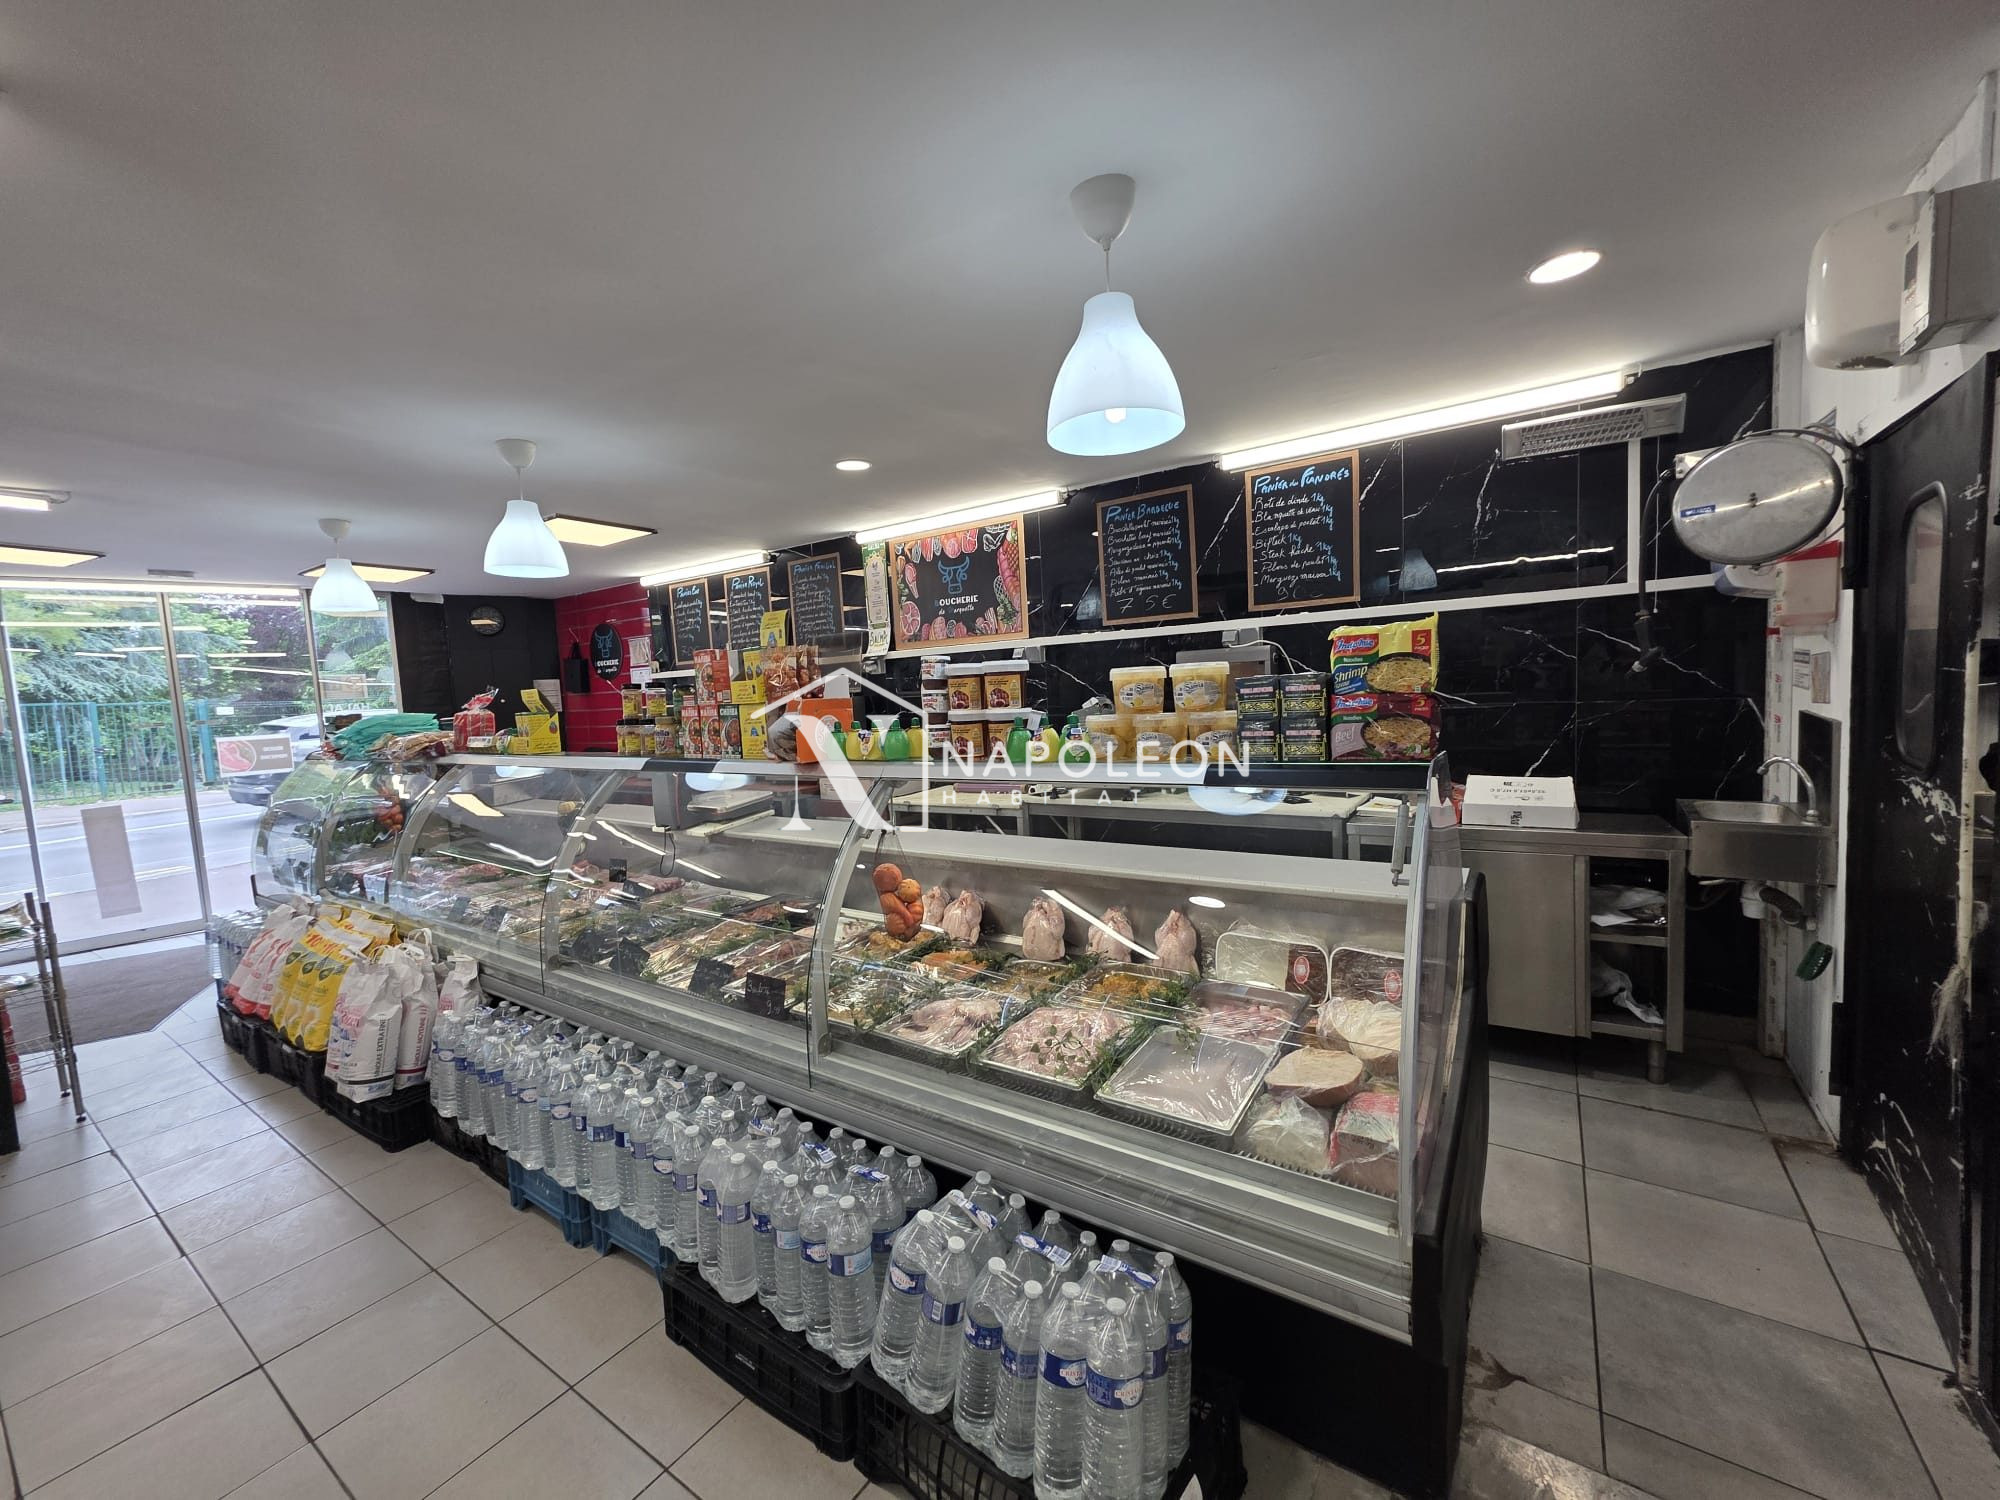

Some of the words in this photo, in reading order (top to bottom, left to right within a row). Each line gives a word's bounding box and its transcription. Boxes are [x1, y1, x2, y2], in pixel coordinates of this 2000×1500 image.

[1416, 632, 1427, 646] 5
[1334, 665, 1368, 682] Shrimp
[1416, 694, 1426, 708] 5
